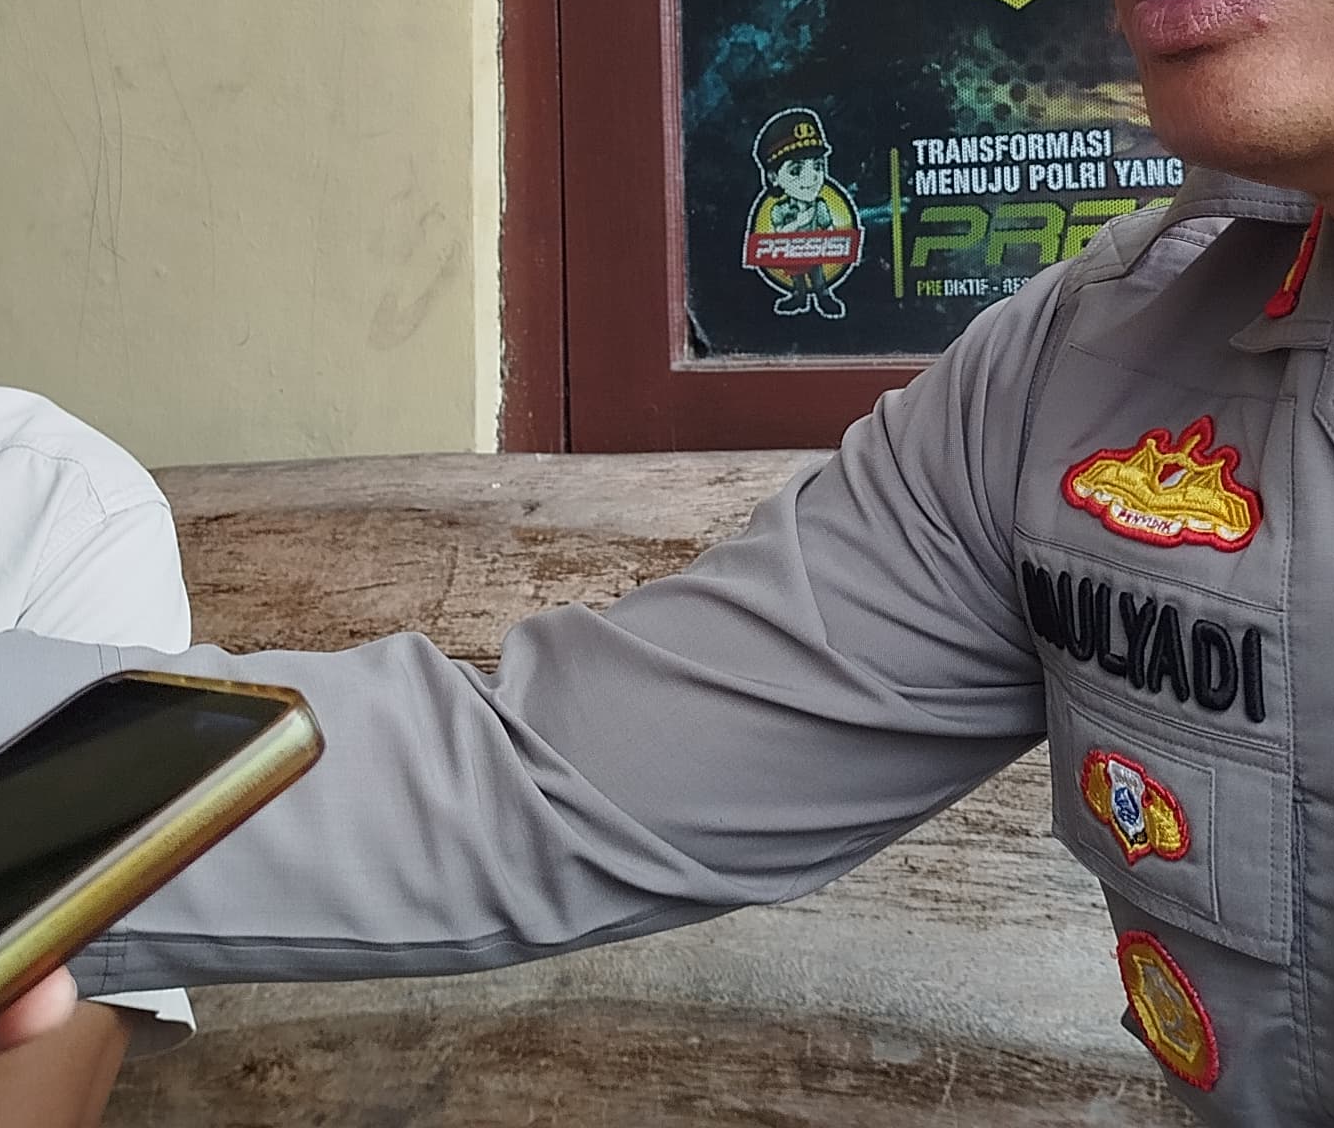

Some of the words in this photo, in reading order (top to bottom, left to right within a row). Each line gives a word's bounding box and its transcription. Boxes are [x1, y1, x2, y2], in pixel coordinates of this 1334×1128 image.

[912, 128, 1112, 165] TRANSFORMASI
[915, 164, 1019, 196] MENUJU
[1029, 161, 1107, 192] POLRI
[1113, 157, 1184, 188] YANG
[910, 197, 1178, 267] PRE
[916, 278, 989, 297] PREDIKTIF
[1021, 560, 1266, 723] MULYADI
